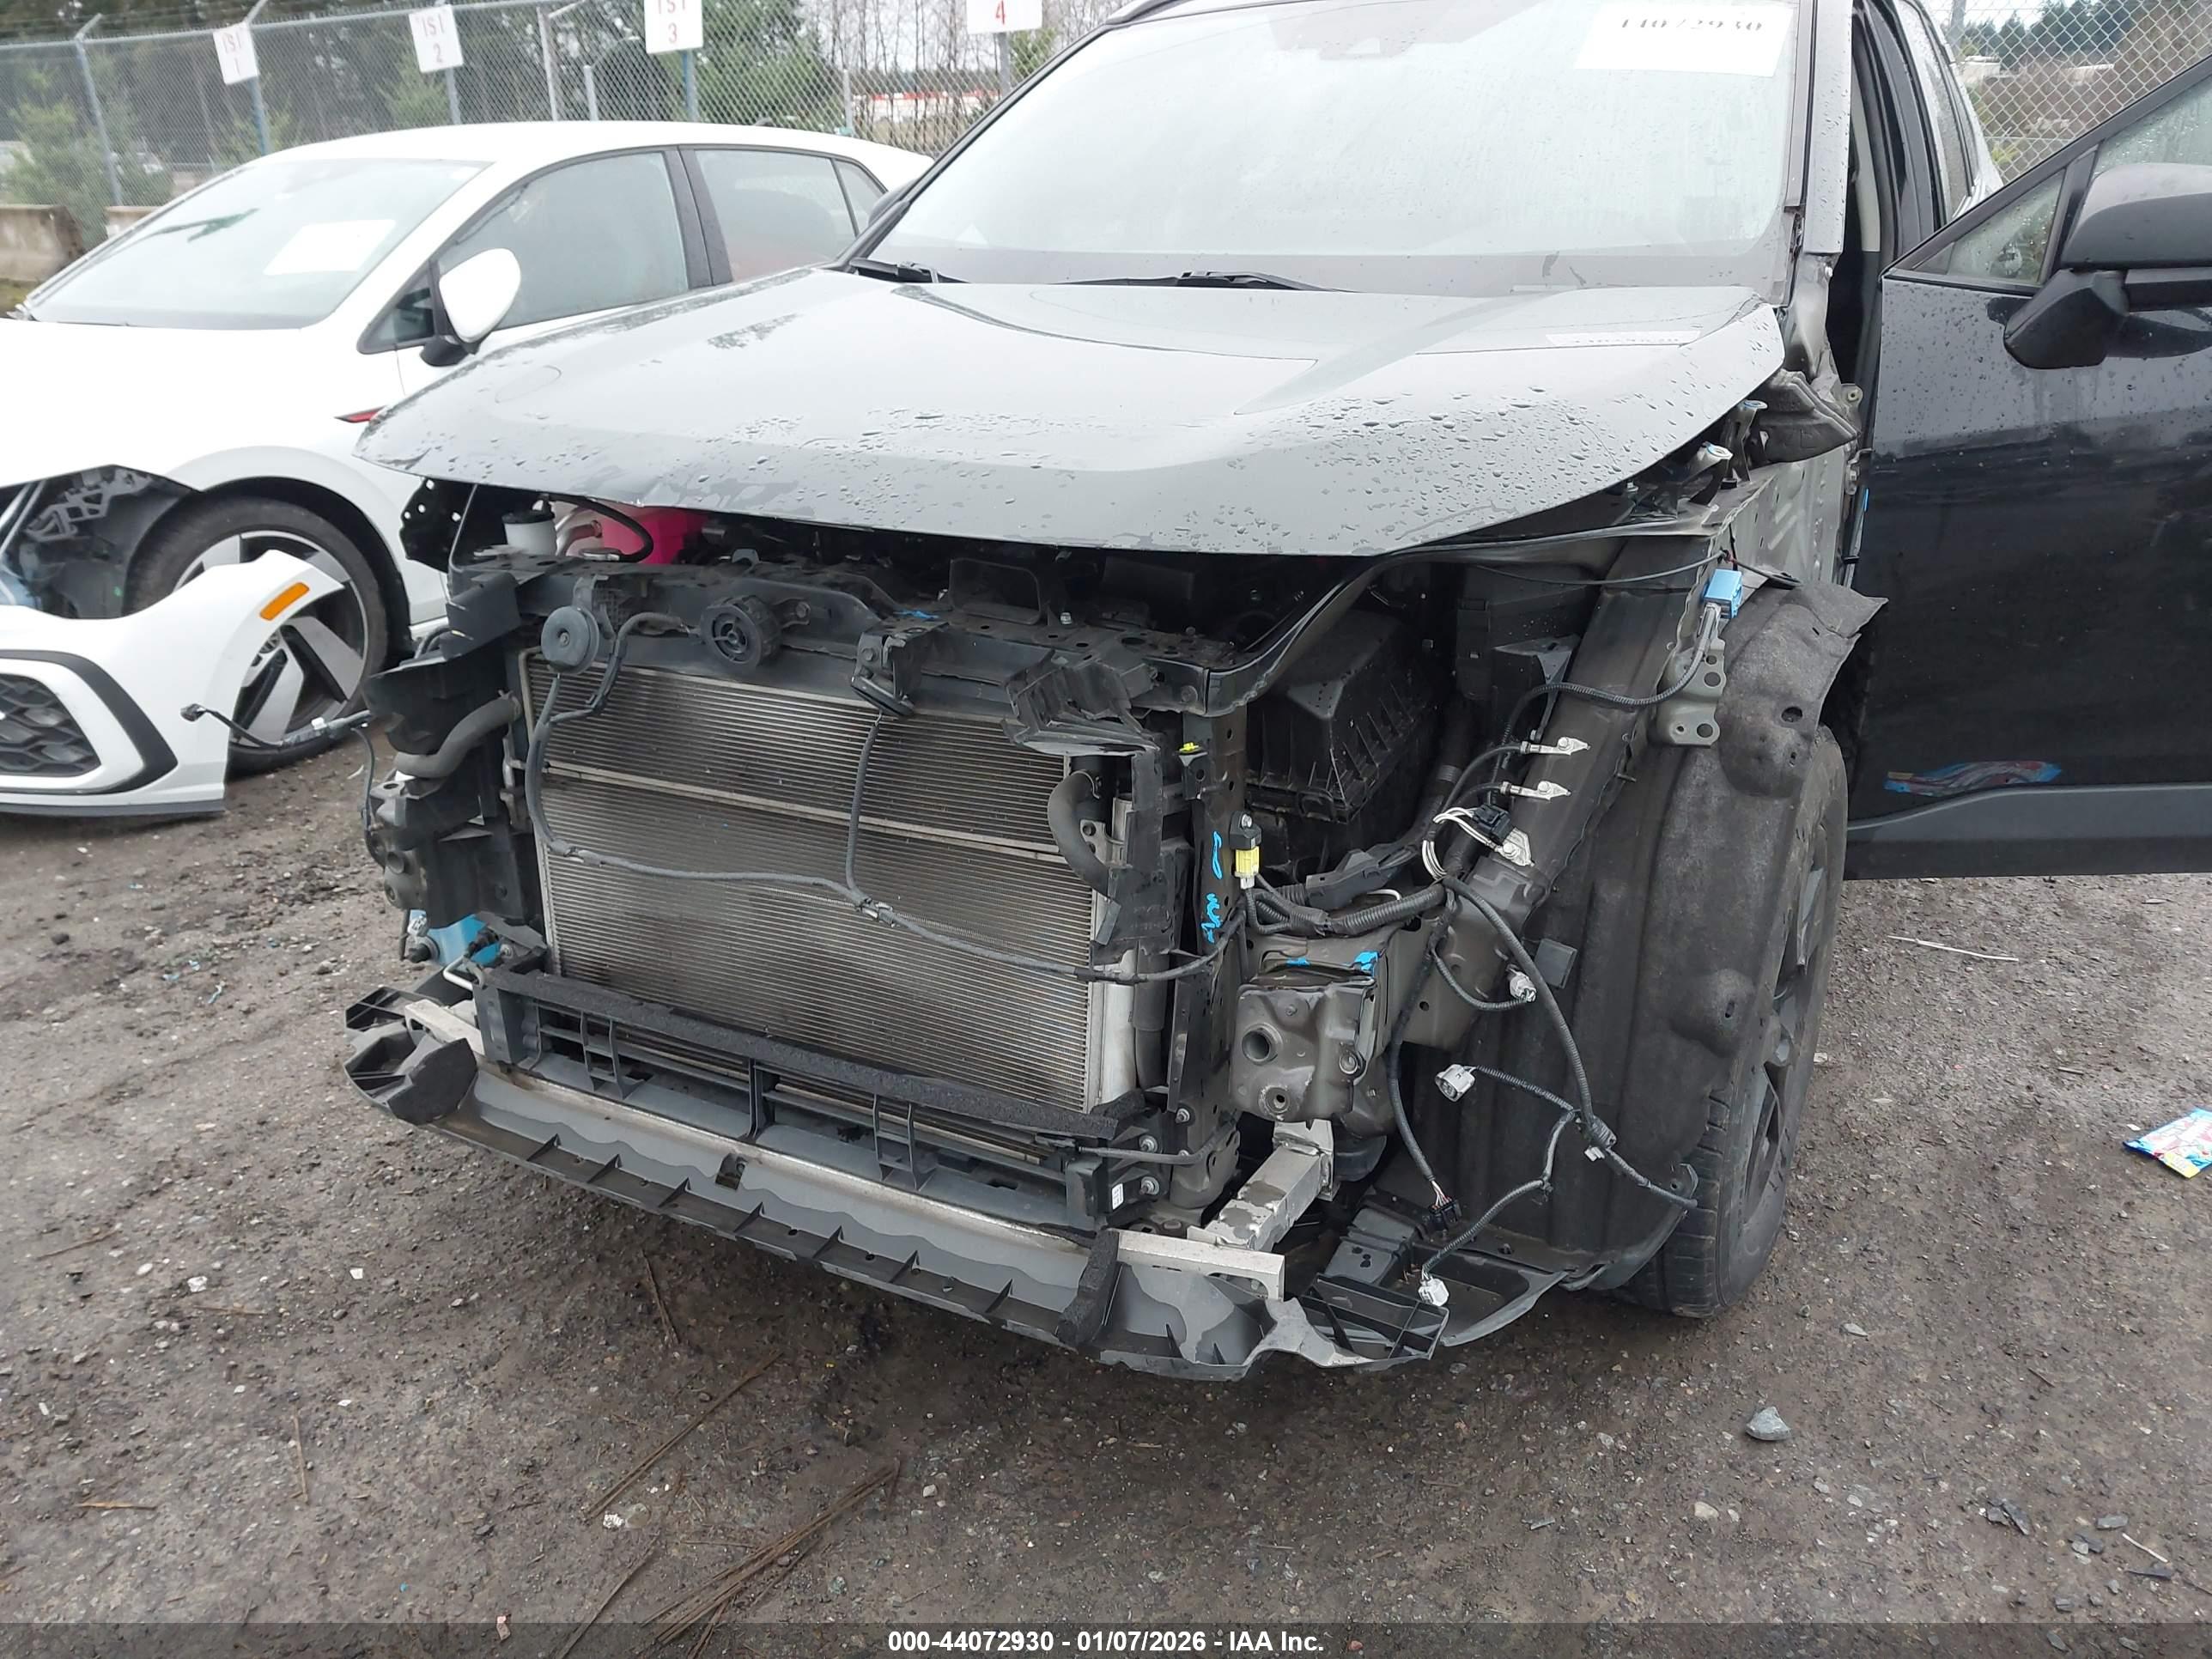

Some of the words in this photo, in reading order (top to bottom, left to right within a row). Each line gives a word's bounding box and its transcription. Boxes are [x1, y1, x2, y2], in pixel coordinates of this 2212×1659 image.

[995, 0, 1006, 25] 4
[667, 21, 678, 44] 3
[432, 42, 445, 64] 2
